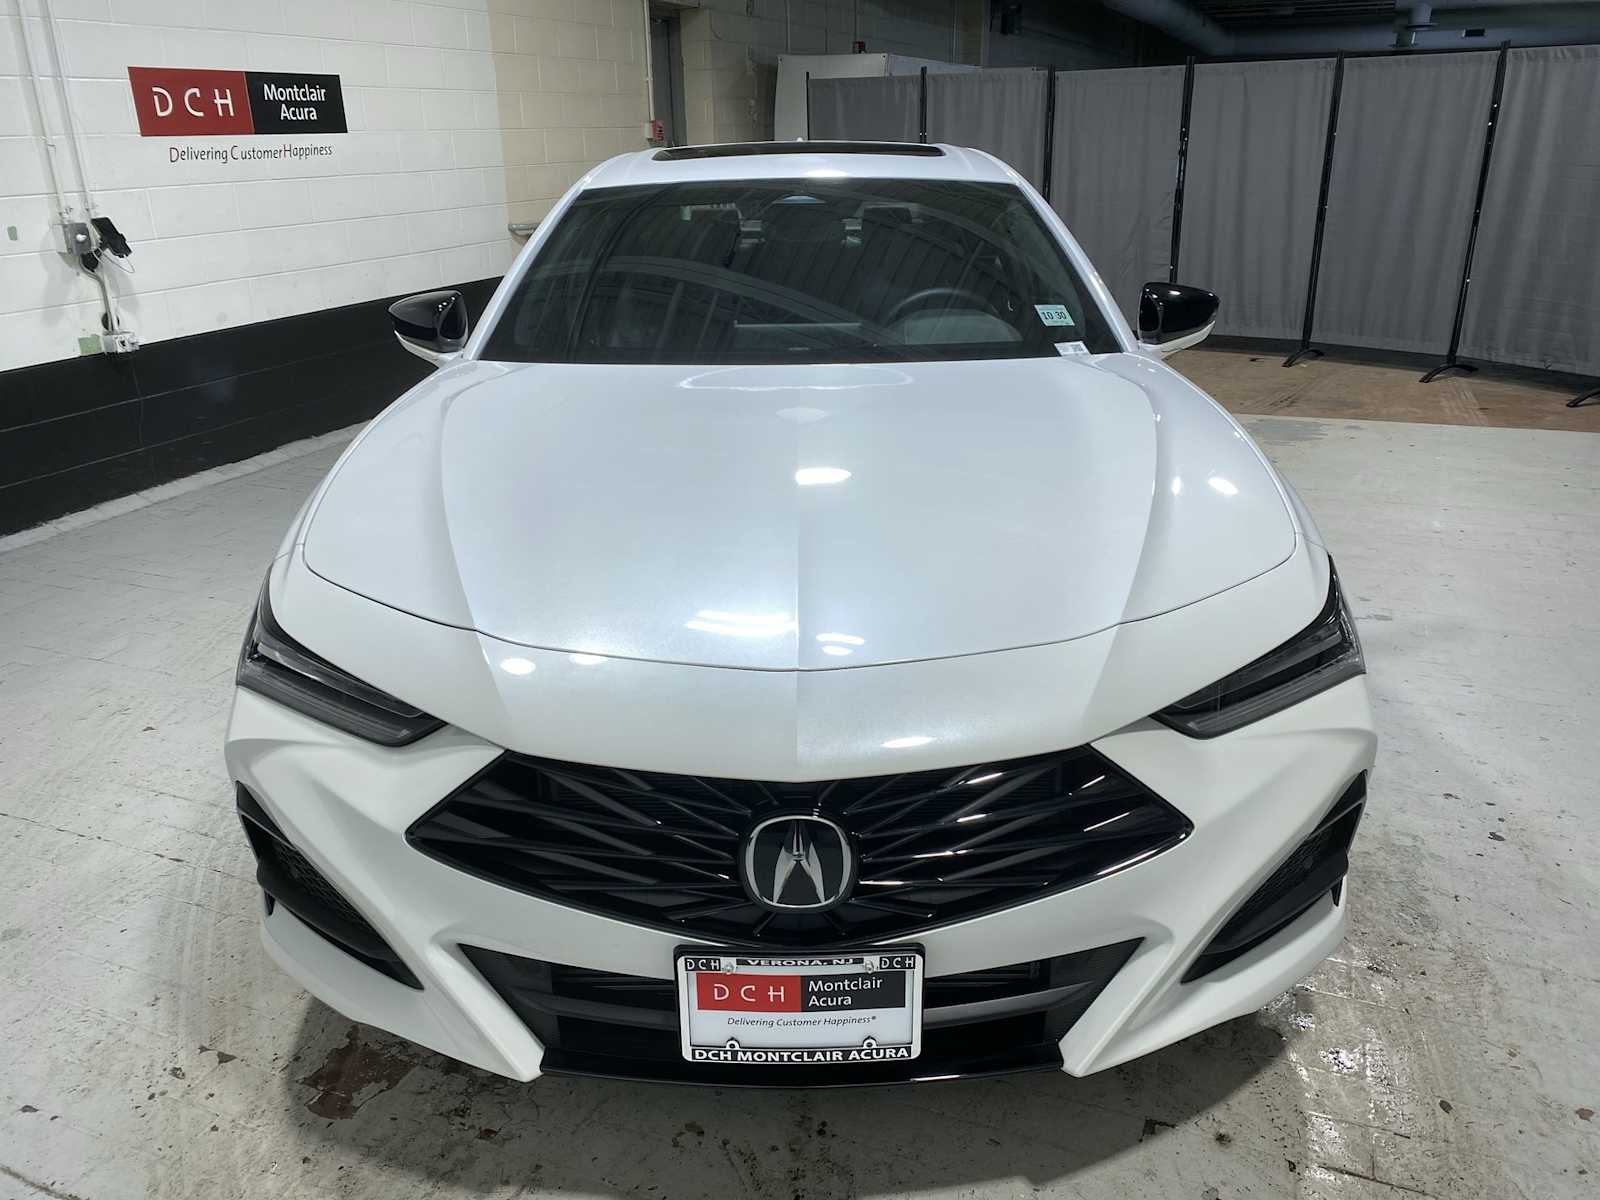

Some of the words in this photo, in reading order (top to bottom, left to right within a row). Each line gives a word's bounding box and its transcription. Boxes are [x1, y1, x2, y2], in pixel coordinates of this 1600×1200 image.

[263, 83, 326, 102] Montclair
[280, 104, 318, 121] Acura
[169, 146, 228, 164] Delivering
[1042, 311, 1054, 320] 10
[1054, 311, 1067, 320] 30
[686, 959, 720, 970] DCH
[881, 956, 914, 969] DCH
[808, 977, 883, 992] Montclair
[713, 983, 785, 1002] DCH
[808, 995, 852, 1007] Acura
[727, 1017, 774, 1028] Delivering
[776, 1018, 821, 1027] Customer
[694, 1050, 732, 1060] DCH
[737, 1050, 843, 1062] MONTCLAIR
[848, 1047, 909, 1060] ACURA
